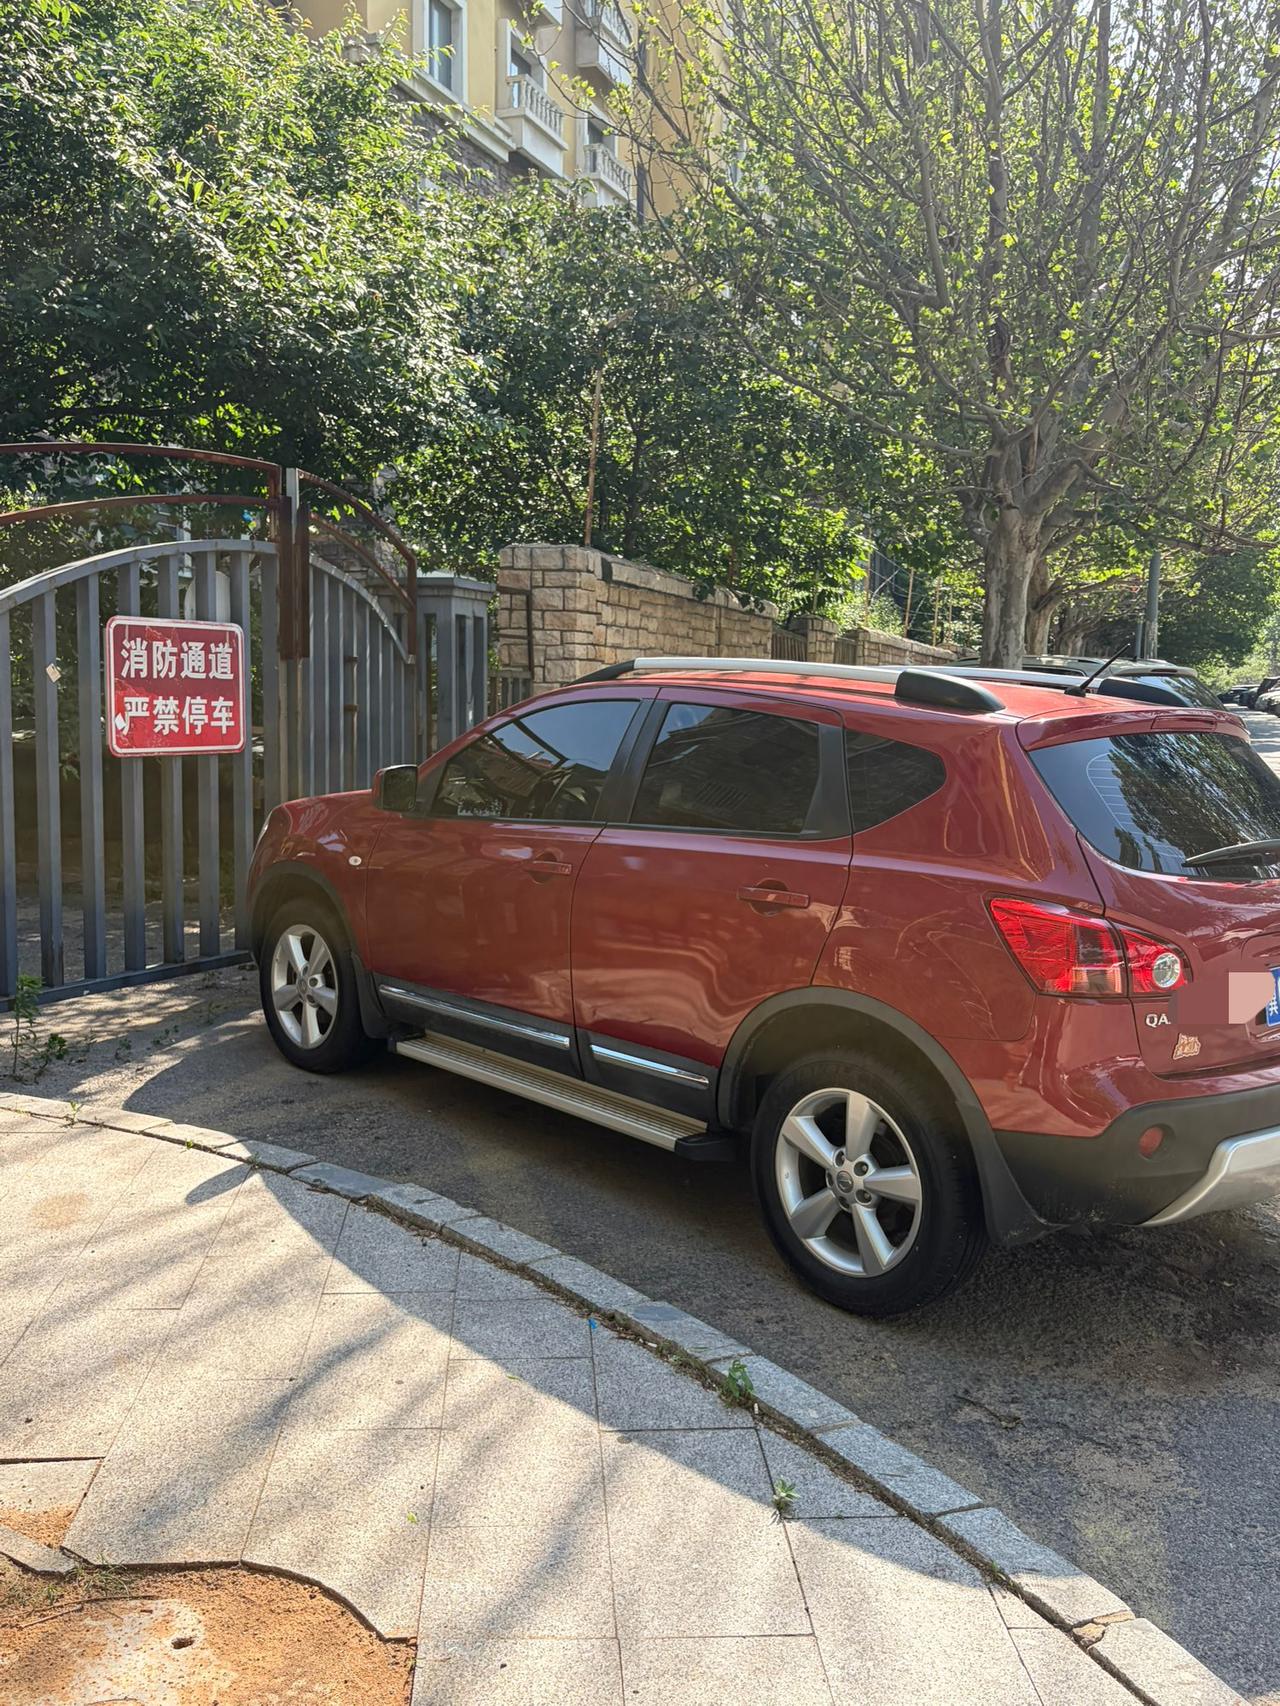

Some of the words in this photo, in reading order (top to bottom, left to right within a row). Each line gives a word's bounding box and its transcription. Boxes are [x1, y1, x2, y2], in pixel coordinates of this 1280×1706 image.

[121, 638, 234, 680] 消防通道
[122, 696, 235, 735] 严禁停车
[1145, 1013, 1171, 1028] QA
